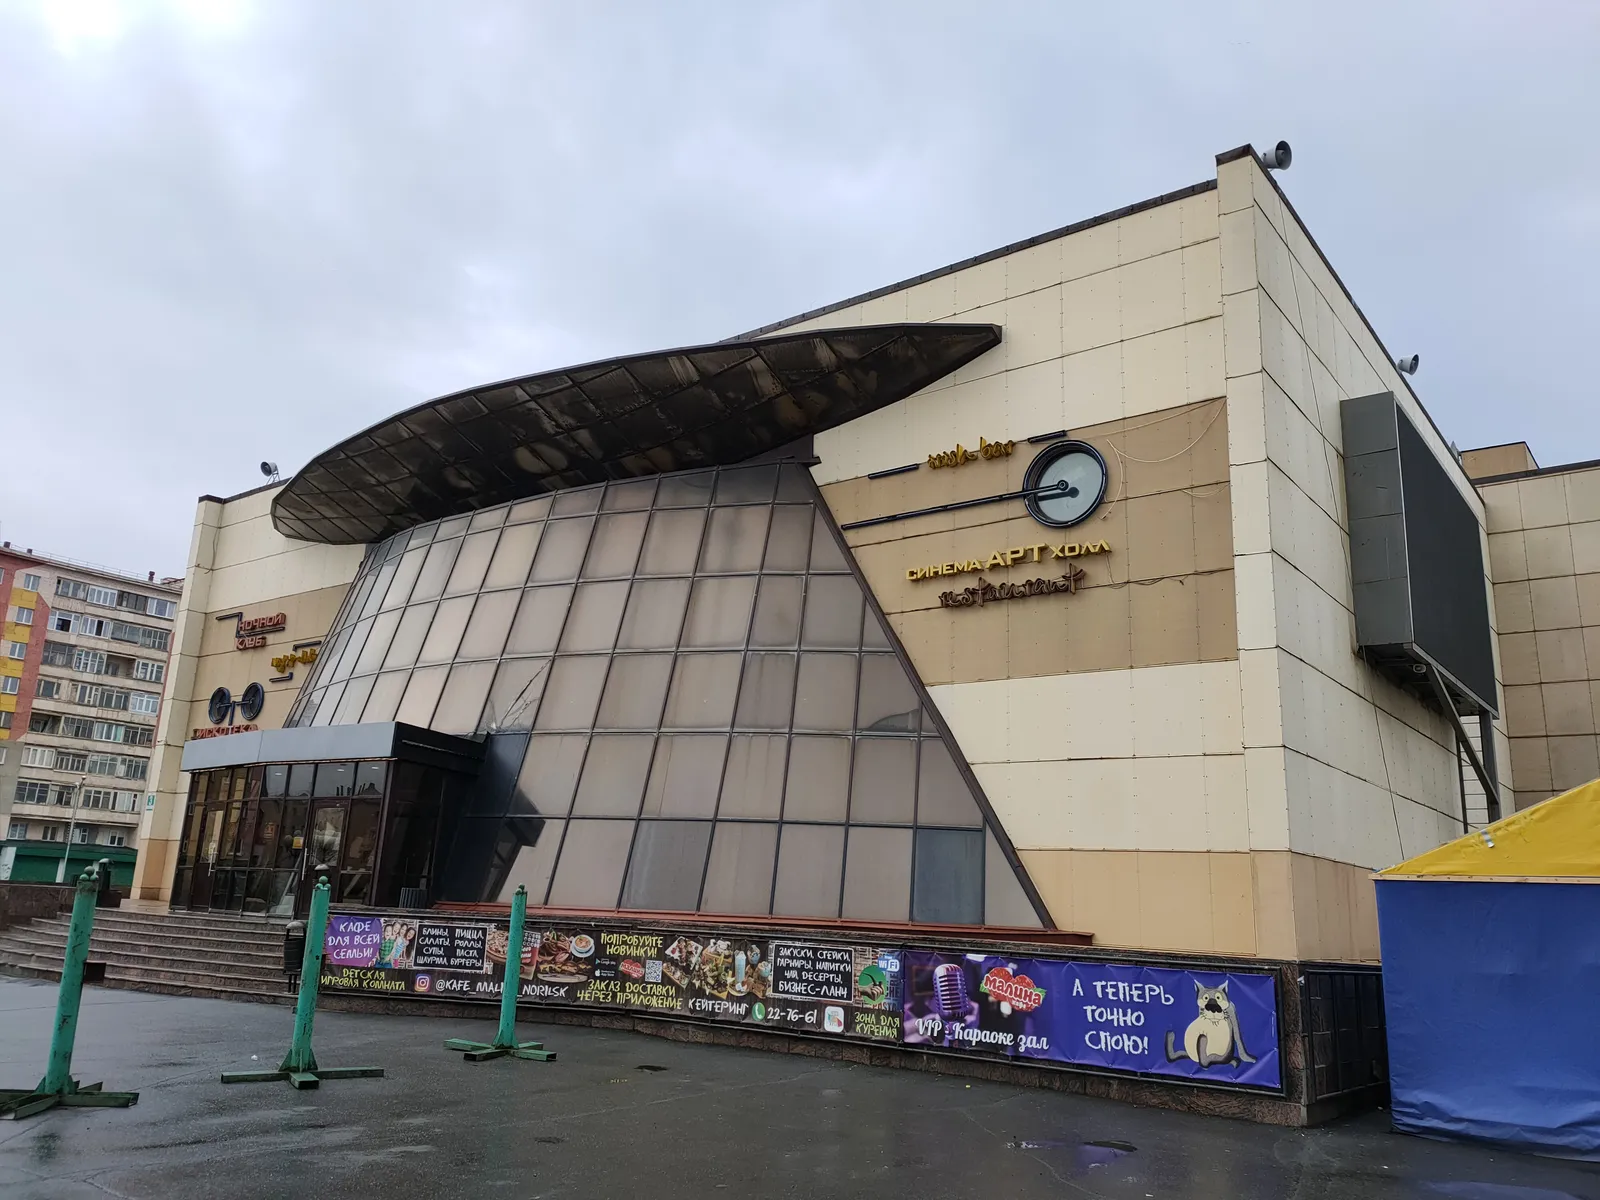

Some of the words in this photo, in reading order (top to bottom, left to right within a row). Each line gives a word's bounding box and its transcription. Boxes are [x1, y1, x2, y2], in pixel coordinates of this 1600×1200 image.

[906, 559, 983, 581] СИНЕМА
[985, 543, 1048, 568] АРТ
[1049, 539, 1112, 560] ХОЛЛ
[237, 612, 287, 633] НОЧНОЙ
[235, 636, 267, 650] КЛУБ
[339, 920, 371, 932] КАФЕ
[328, 937, 350, 946] ДЛЯ
[353, 934, 380, 945] ВСЕЙ
[600, 933, 664, 948] ПОПРОБУЙТЕ
[333, 948, 373, 959] СЕМЬИ!
[606, 944, 657, 957] НОВИНКИ!
[342, 968, 385, 980] ДЕТСКАЯ
[320, 975, 359, 988] ИГРОВАЯ
[362, 979, 406, 991] КОМНАТА
[587, 980, 621, 992] ЗАКАЗ
[625, 982, 676, 997] ДОСТАВКИ
[778, 980, 848, 998] БИЗНЕС-ЛАНЧ
[577, 990, 613, 1003] ЧЕРЕЗ
[616, 992, 683, 1009] ПРИЛОЖЕНИЕ
[1072, 978, 1085, 997] А
[1092, 980, 1175, 1006] ТЕПЕРЬ
[688, 998, 749, 1016] КЕЙТЕРИНГ
[767, 1007, 817, 1024] 22-76-61
[855, 1011, 876, 1025] ЗОНА
[880, 1015, 900, 1028] ДЛЯ
[1082, 1005, 1146, 1027] ТОЧНО
[855, 1022, 898, 1039] КУРЕНИЯ
[914, 1018, 943, 1037] VIP
[952, 1022, 1015, 1047] Караоке
[1016, 1034, 1050, 1052] зал
[1084, 1030, 1149, 1055] СПОЮ!
